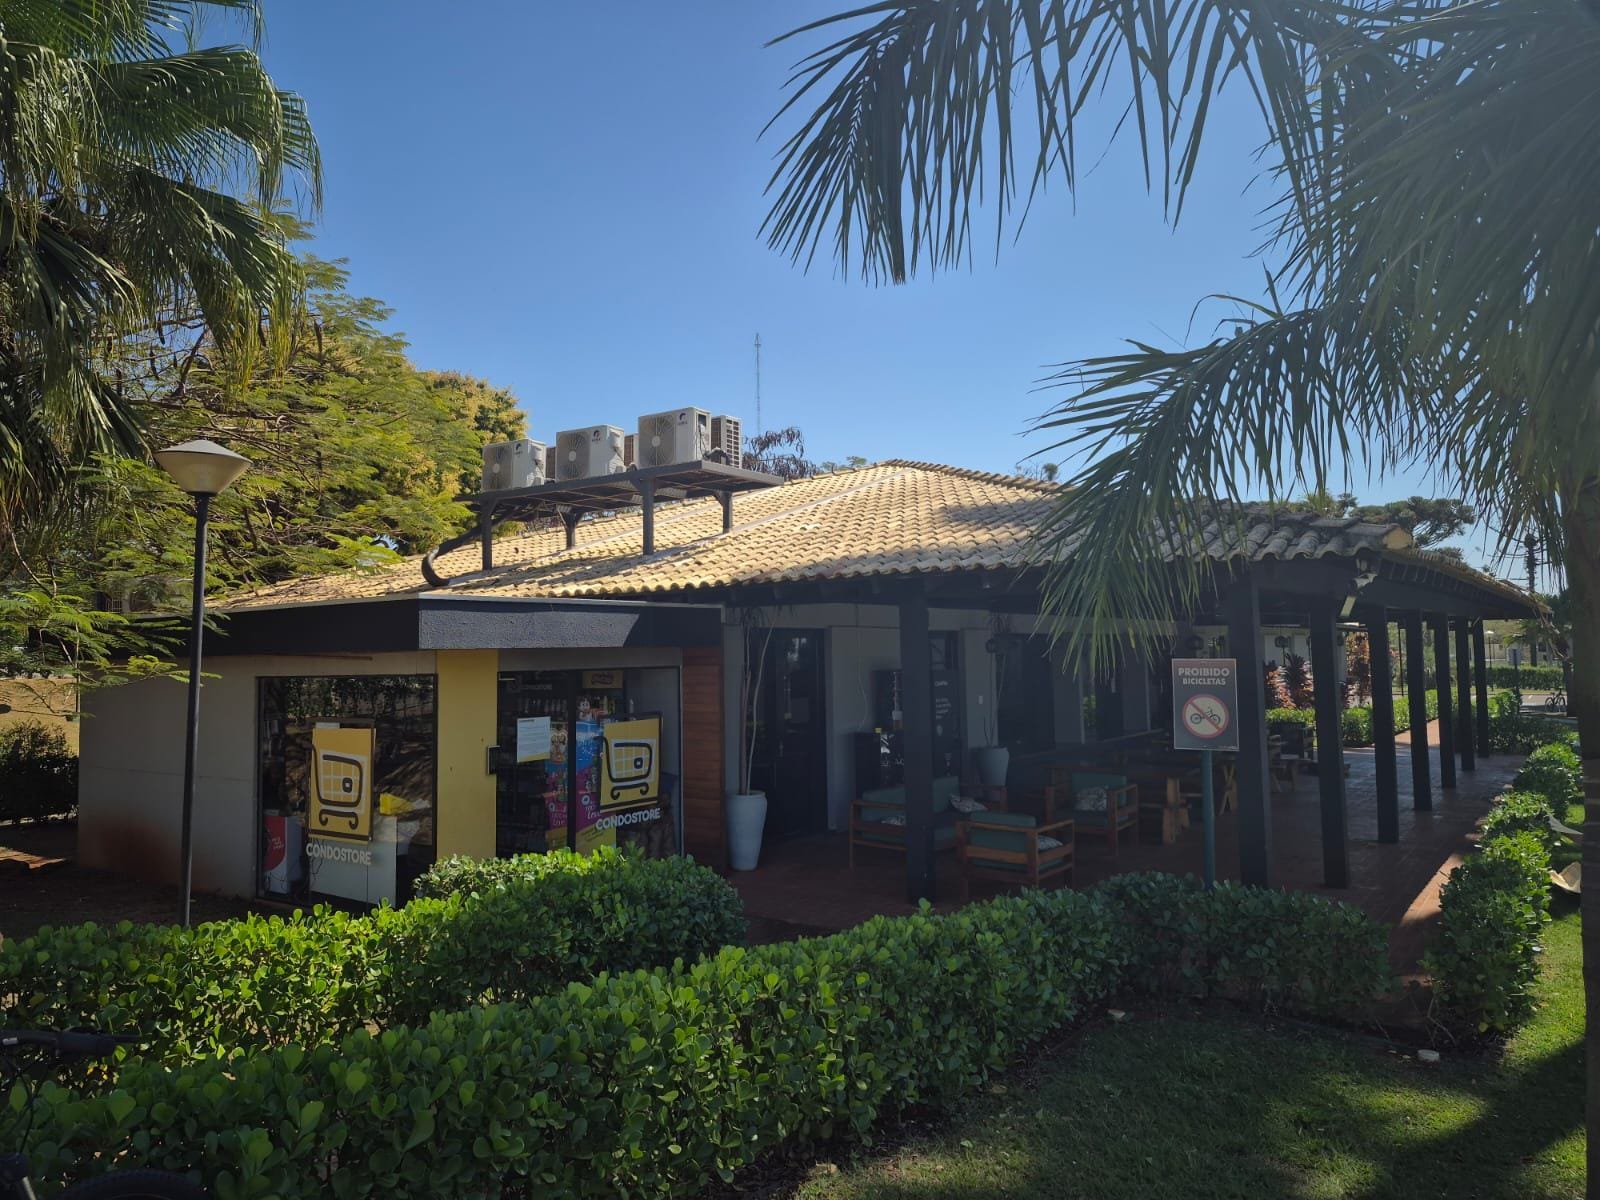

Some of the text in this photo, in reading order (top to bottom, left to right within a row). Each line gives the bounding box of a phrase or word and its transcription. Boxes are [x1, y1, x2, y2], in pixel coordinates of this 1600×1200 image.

[1178, 667, 1230, 677] PROIBIDO
[1182, 677, 1226, 686] BICICLETAS
[595, 808, 661, 831] CONDOSTORE
[306, 842, 372, 865] CONDOSTORE
